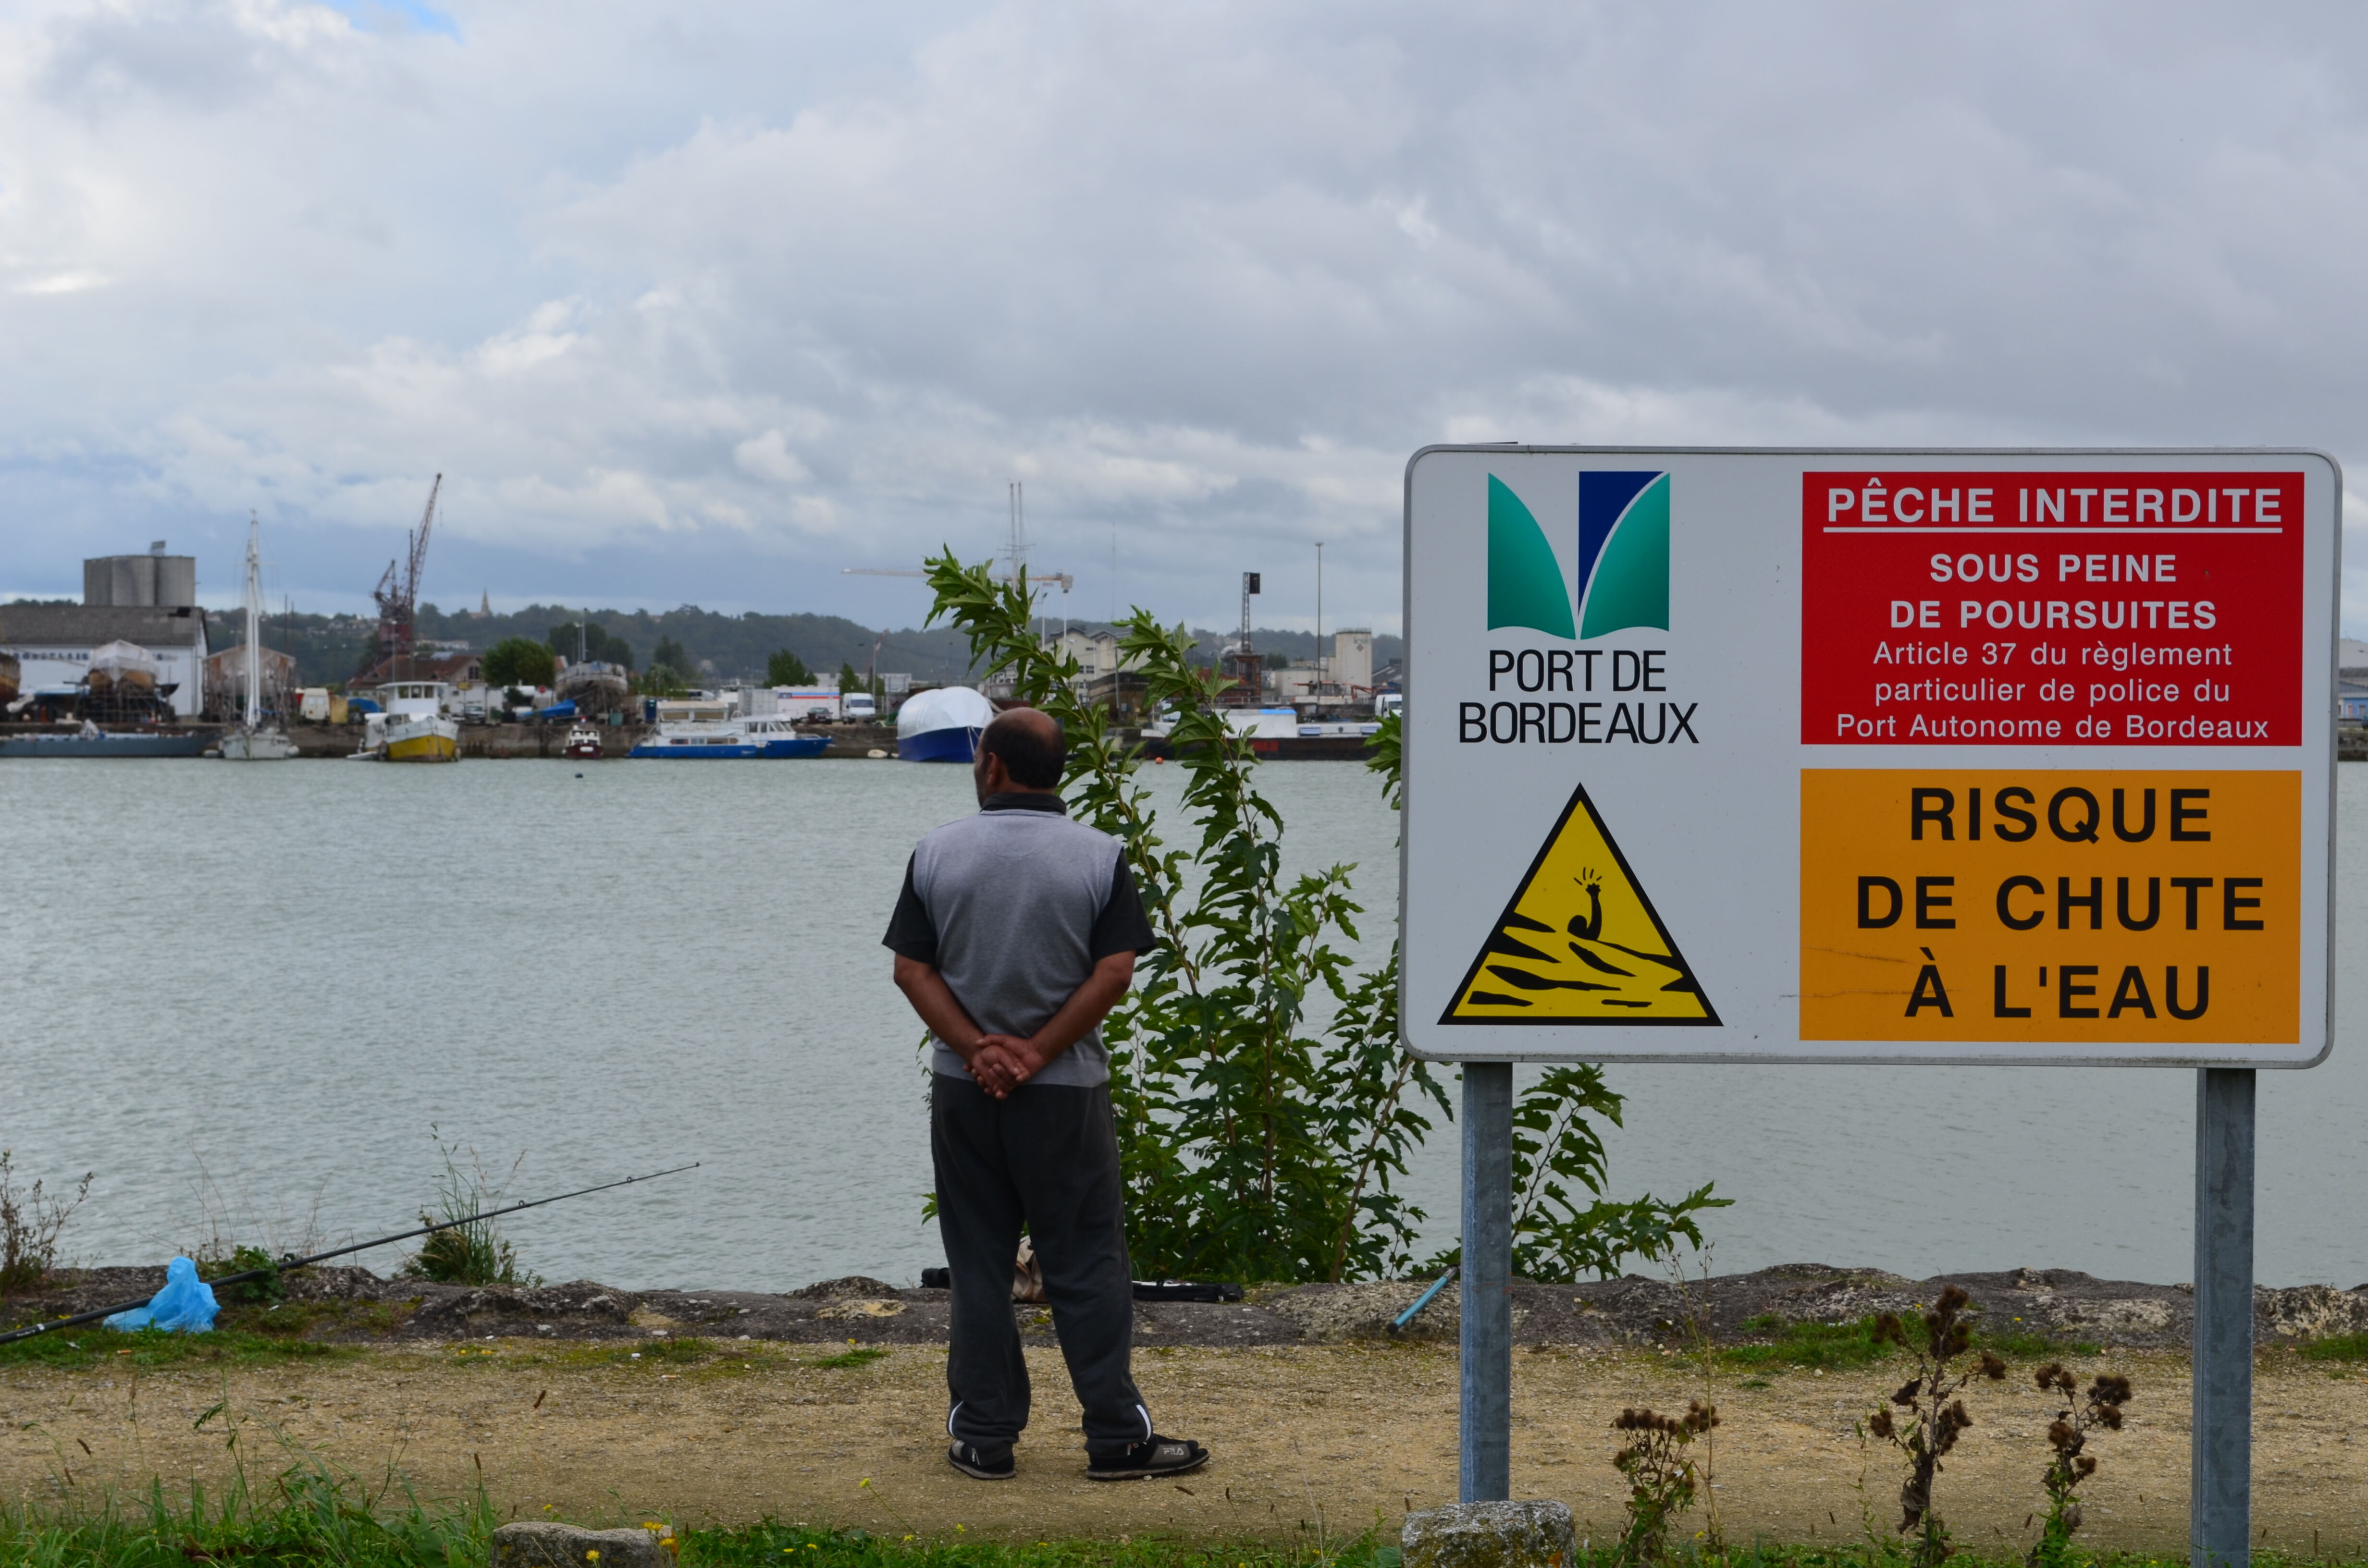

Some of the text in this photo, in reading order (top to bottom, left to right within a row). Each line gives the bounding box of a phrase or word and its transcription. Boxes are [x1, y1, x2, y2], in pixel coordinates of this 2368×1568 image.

[1828, 478, 2282, 523] PÊCHE INTERDITE
[1930, 553, 2176, 582] SOUS PEINE
[1891, 600, 2216, 629] DE POURSUITES
[1490, 649, 1666, 692] PORT DE
[1873, 640, 2232, 671] Article 37 du règlement
[1876, 678, 2230, 707] particulier de police du
[1459, 701, 1699, 744] BORDEAUX
[1838, 714, 2268, 738] Port Autonome de Bordeaux
[1912, 786, 2211, 844] RISQUE
[1858, 875, 2264, 931] DE CHUTE
[1904, 947, 2209, 1020] À L'EAU
[1163, 1447, 1184, 1456] FILA
